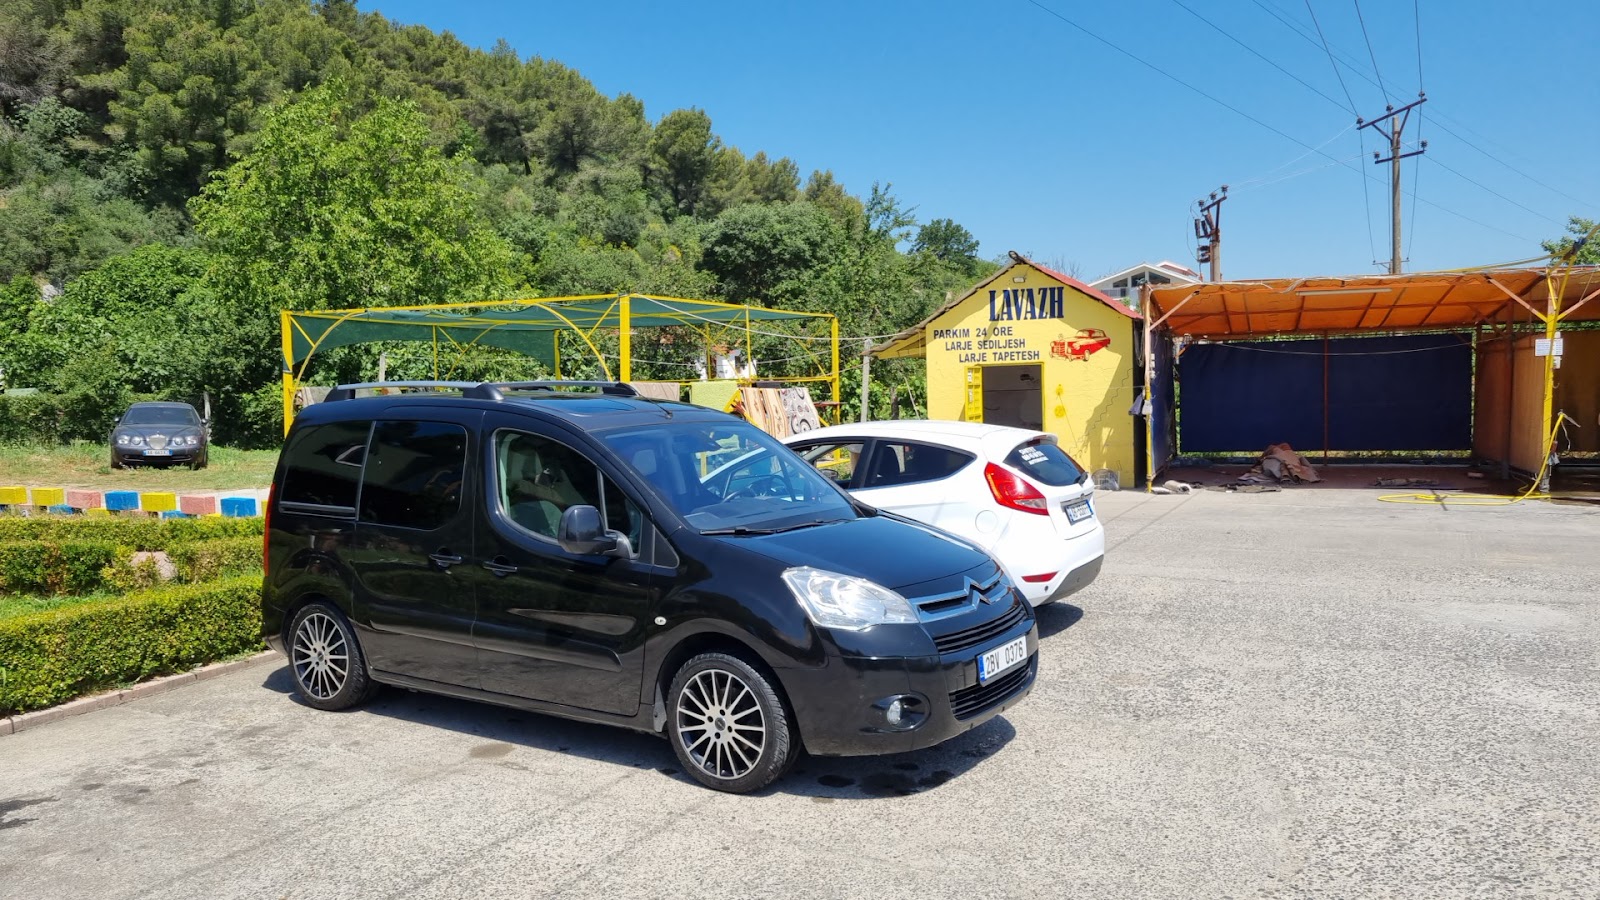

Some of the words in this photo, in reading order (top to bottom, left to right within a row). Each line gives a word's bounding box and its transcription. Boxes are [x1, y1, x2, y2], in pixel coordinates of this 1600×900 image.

[988, 286, 1065, 322] LAVAZH
[933, 329, 970, 340] PARKIM
[975, 328, 988, 338] 24
[992, 326, 1013, 337] ORE
[945, 340, 972, 351] LARJE
[977, 339, 1026, 350] SEDILJESH
[959, 352, 987, 363] LARJE
[992, 351, 1040, 361] TAPETESH
[985, 651, 1000, 675] 2BV
[1004, 640, 1024, 665] 0376
